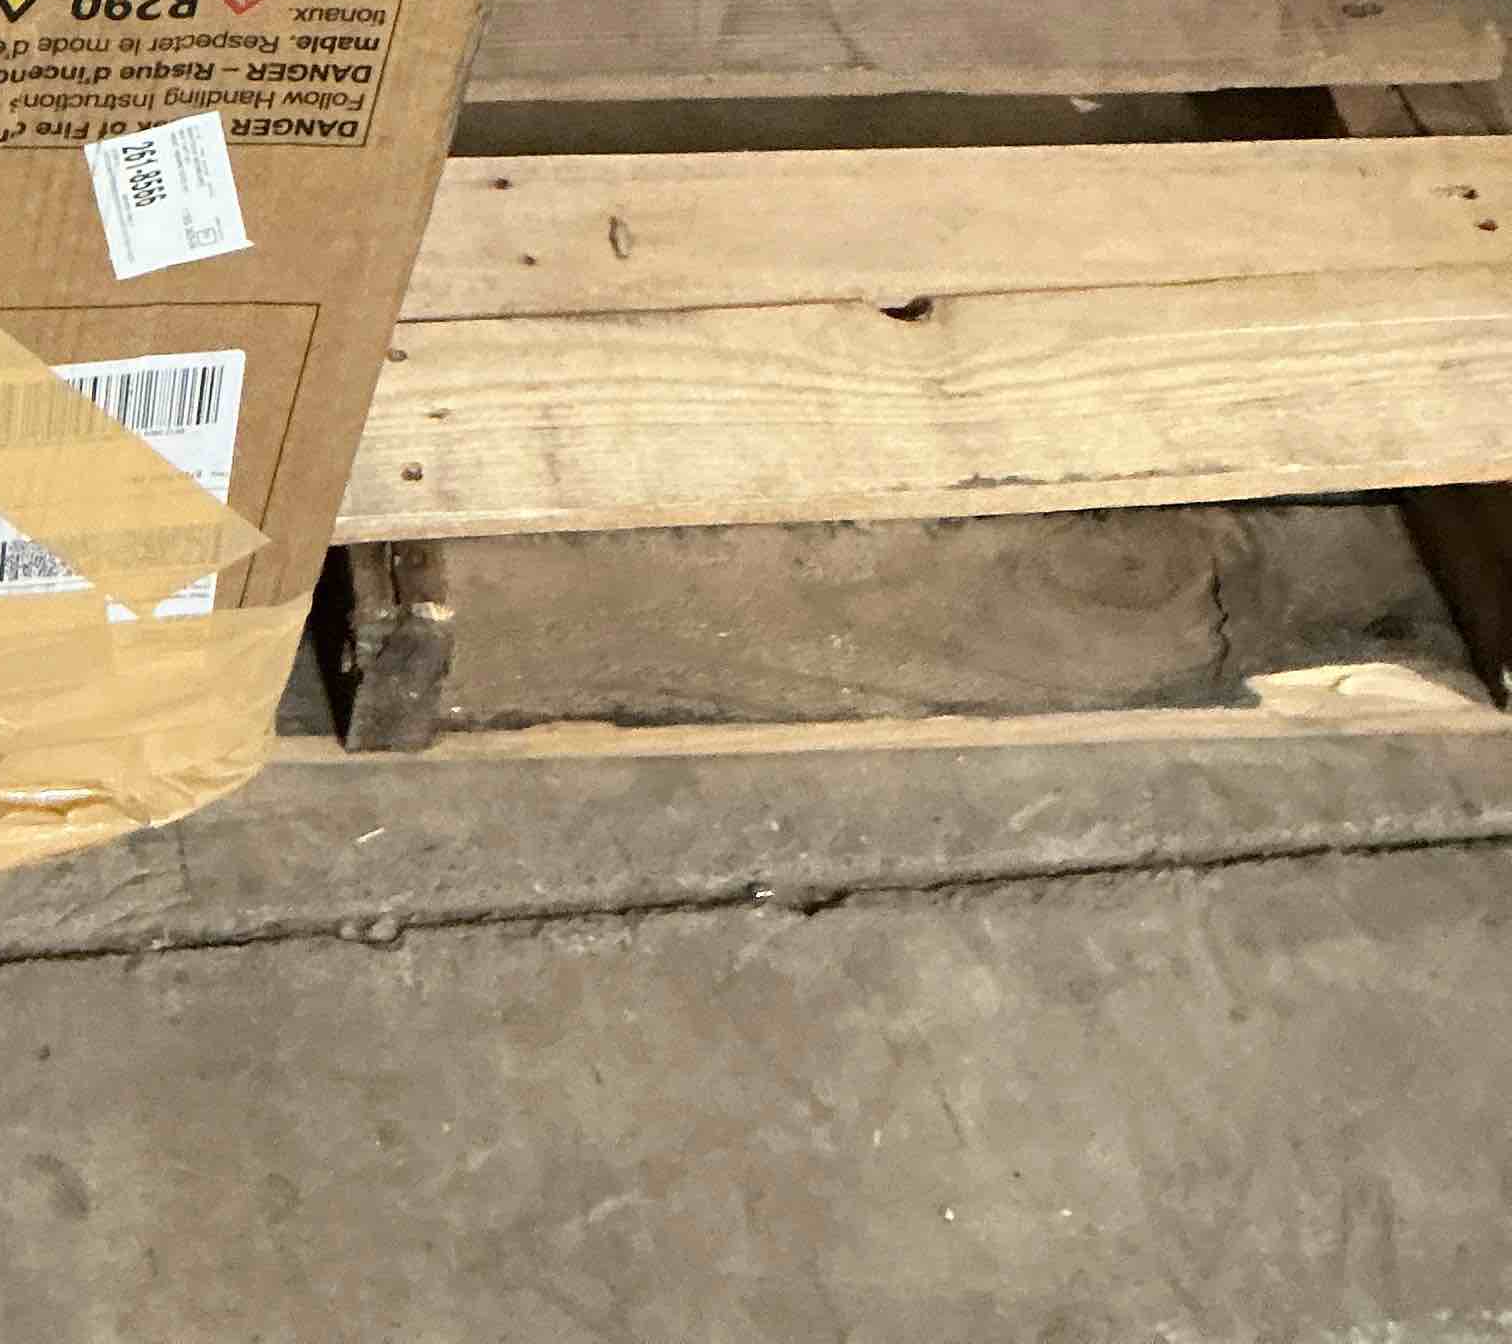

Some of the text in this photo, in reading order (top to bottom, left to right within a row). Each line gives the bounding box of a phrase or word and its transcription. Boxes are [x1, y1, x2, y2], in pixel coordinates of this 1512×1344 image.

[288, 6, 387, 26] tionaux.
[37, 36, 110, 57] mode
[117, 36, 140, 56] le
[148, 31, 281, 54] Respecter
[290, 34, 381, 54] mable.
[119, 60, 215, 83] Risque
[246, 62, 373, 84] DANGER
[164, 86, 276, 111] Handling
[282, 91, 365, 111] Follow
[35, 121, 90, 141] Fire
[98, 121, 126, 142] of
[231, 118, 359, 138] DANGER
[121, 140, 167, 208] 261-8566
